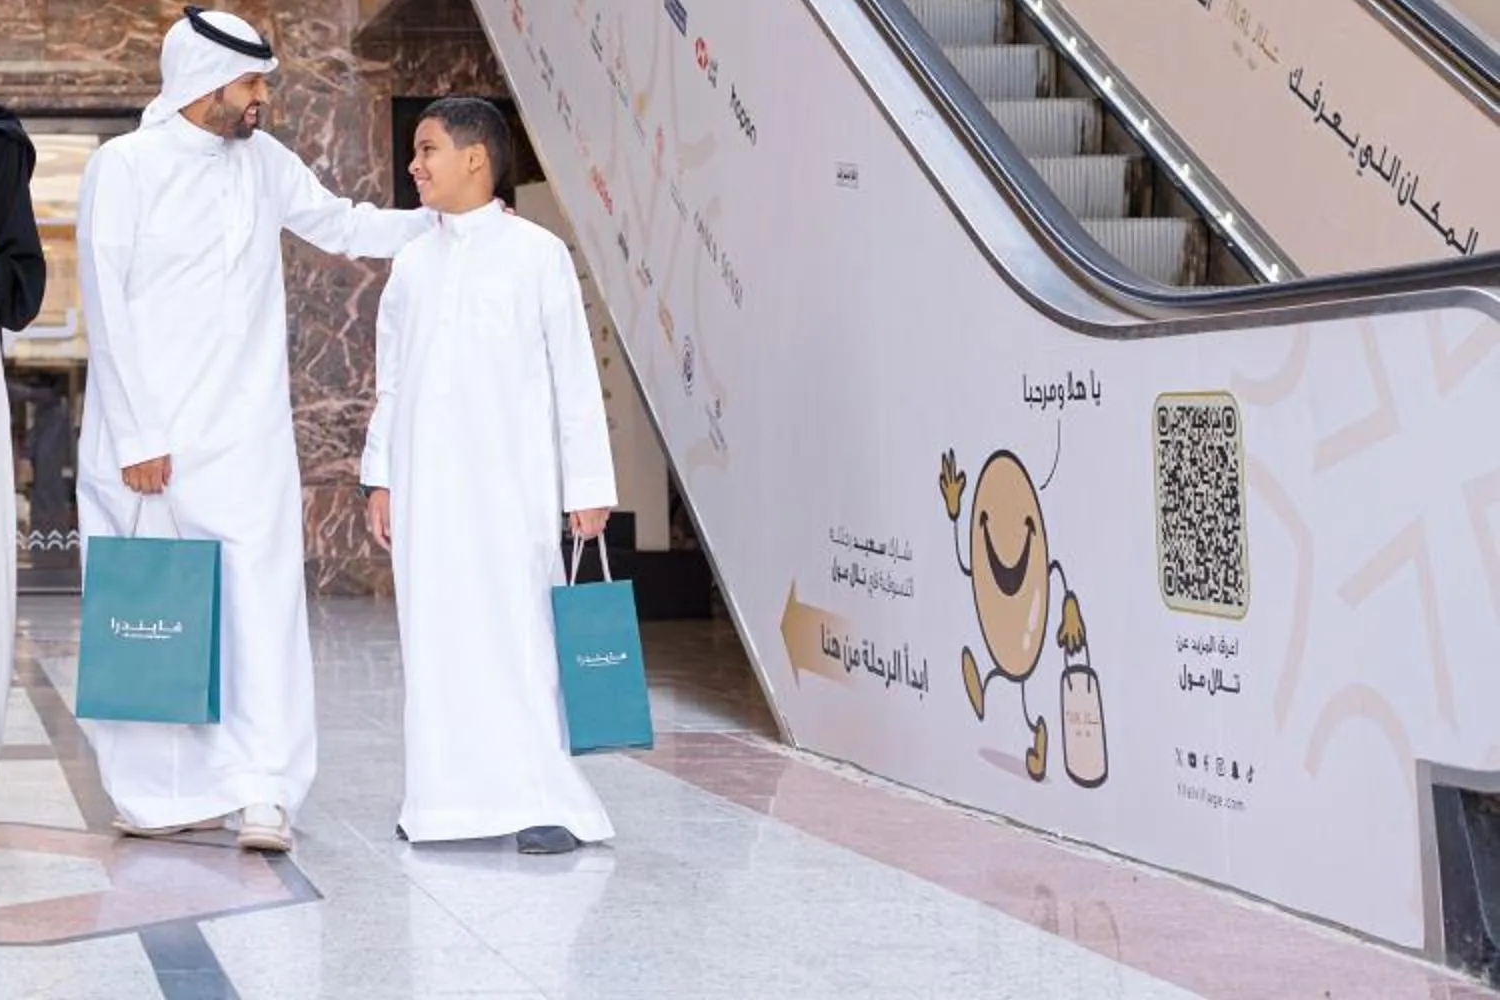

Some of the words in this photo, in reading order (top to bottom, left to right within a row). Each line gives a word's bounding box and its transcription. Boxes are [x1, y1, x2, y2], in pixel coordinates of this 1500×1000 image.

[1288, 67, 1359, 159] يعرفك
[1355, 144, 1401, 189] اللي
[1397, 171, 1480, 256] المكان
[1067, 370, 1087, 402] هلا
[1089, 367, 1102, 407] يا
[819, 622, 842, 661] هنا
[842, 635, 861, 674] من
[861, 638, 902, 690] الرحلة
[904, 643, 930, 701] ابدأ
[1179, 663, 1207, 692] مول
[1207, 667, 1241, 696] تلال
